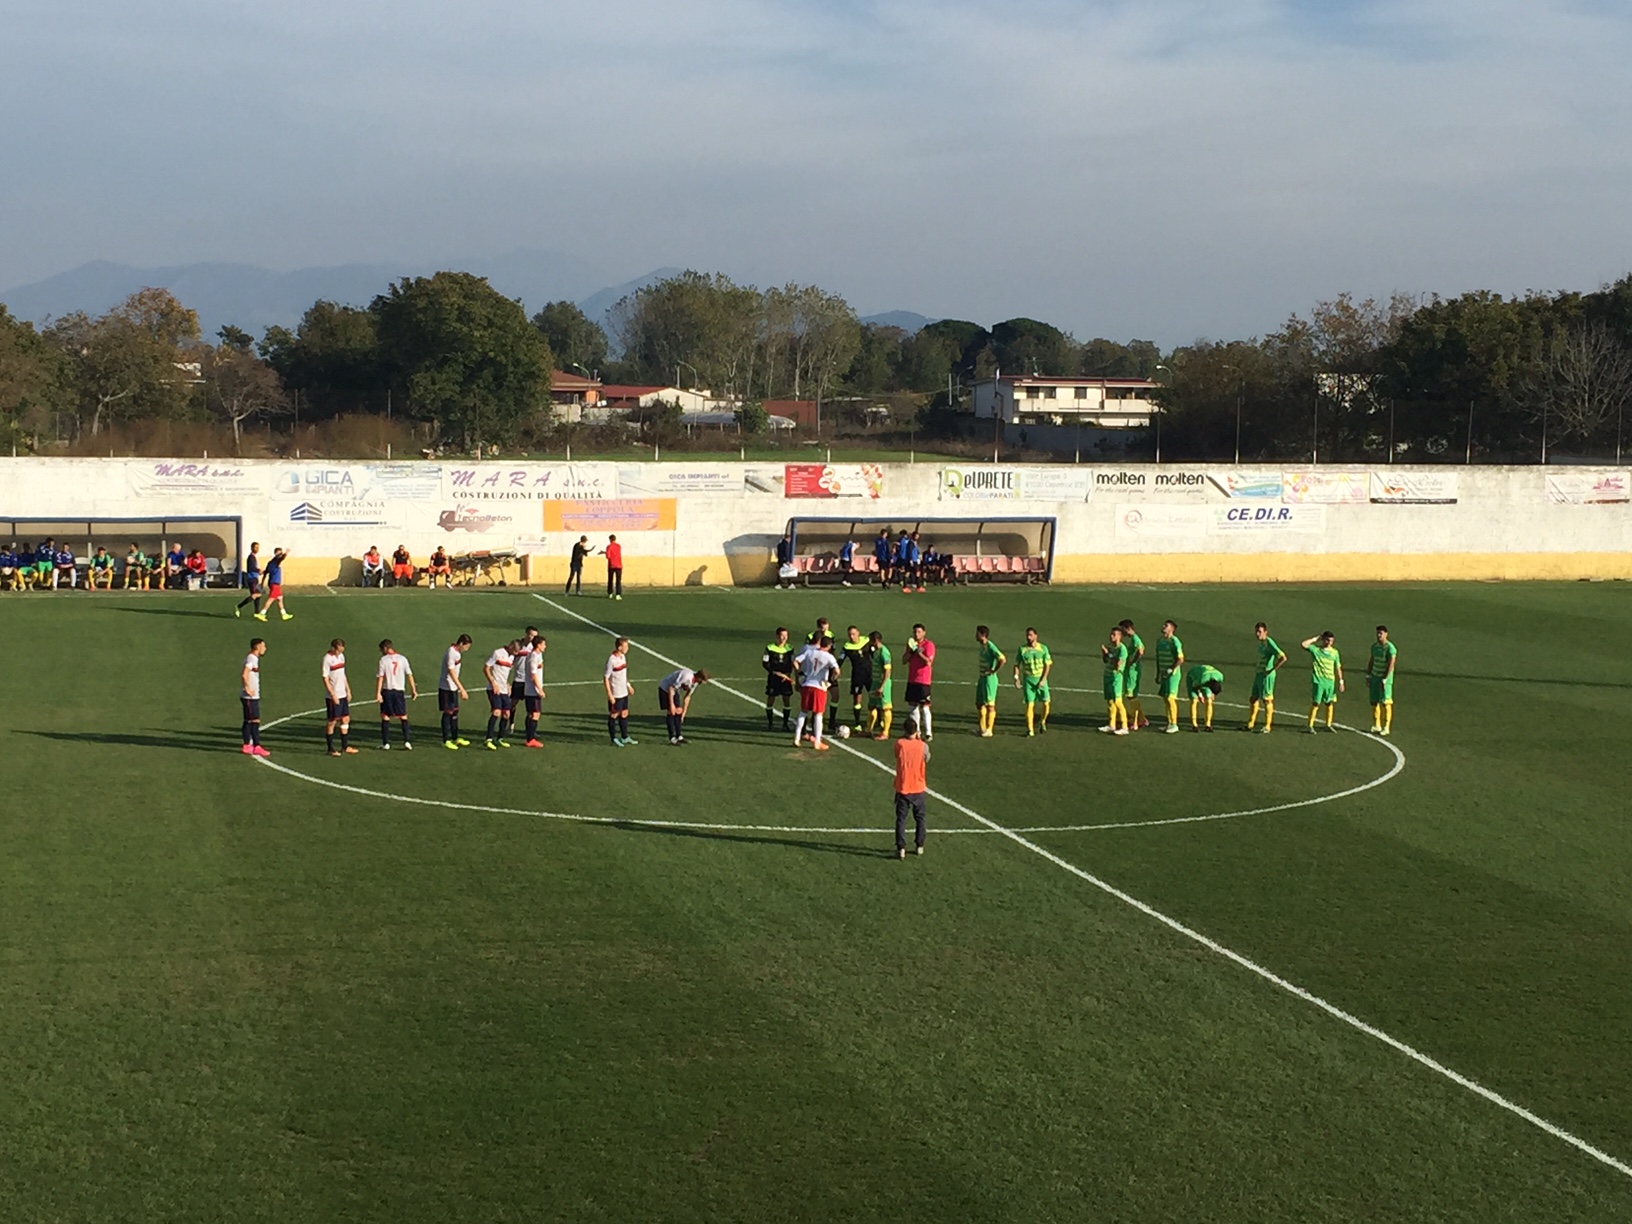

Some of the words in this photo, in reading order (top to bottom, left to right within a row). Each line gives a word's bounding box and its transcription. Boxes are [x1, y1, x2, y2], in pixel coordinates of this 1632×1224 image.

[154, 464, 209, 477] MARA
[305, 470, 353, 485] GICA
[451, 470, 551, 487] MARA
[1096, 472, 1146, 485] molten
[1155, 472, 1204, 485] molten
[306, 485, 354, 495] IMPIANTI
[452, 491, 532, 499] COSTRUZIONI
[554, 490, 603, 500] QUALITÀ
[1226, 508, 1293, 521] CE.DI.R.
[392, 661, 398, 676] 7
